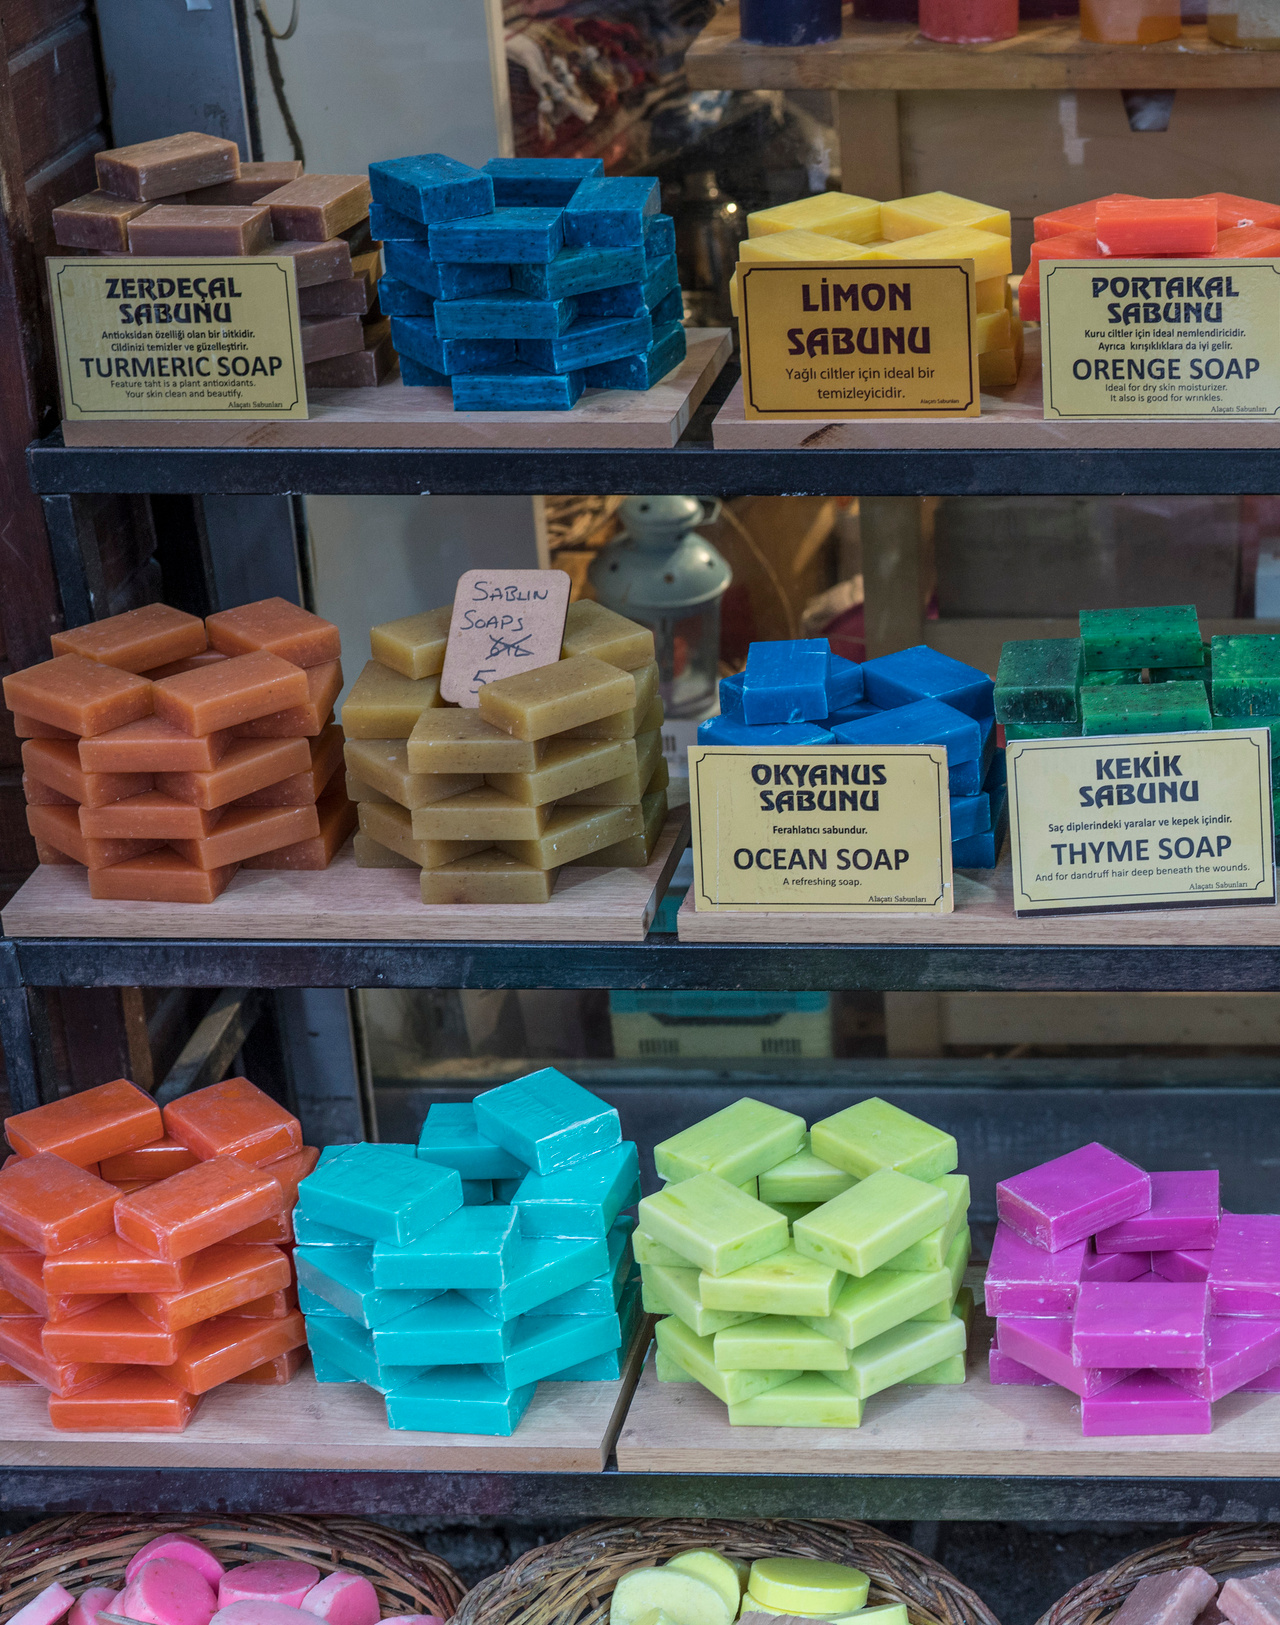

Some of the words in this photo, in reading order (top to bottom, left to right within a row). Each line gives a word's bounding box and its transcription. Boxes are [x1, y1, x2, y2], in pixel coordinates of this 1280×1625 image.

[106, 278, 242, 304] ZERDEÇAL
[802, 278, 911, 311] LİMON
[1092, 277, 1239, 300] PORTAKAL
[119, 301, 231, 326] SABUNU
[1108, 302, 1222, 326] SABUNU
[101, 330, 154, 340] Antioksidan
[154, 329, 185, 341] özelliği
[186, 329, 207, 339] olan
[207, 329, 221, 339] bir
[222, 329, 256, 339] bitkidir.
[787, 327, 930, 358] SABUNU
[1084, 329, 1106, 338] Kuru
[1107, 328, 1133, 338] ciltler
[1135, 328, 1151, 340] için
[1152, 328, 1175, 338] ideal
[1176, 328, 1246, 338] nemlendiricidir.
[110, 342, 145, 352] Cildinizi
[146, 342, 183, 352] temizler
[184, 344, 195, 352] ve
[196, 341, 249, 353] güzelleştirir.
[80, 357, 210, 377] TURMERIC
[218, 357, 282, 376] SOAP
[785, 367, 817, 383] Yağlı
[819, 367, 856, 380] ciltler
[858, 367, 881, 382] için
[883, 366, 915, 379] ideal
[917, 366, 935, 379] bir
[1073, 359, 1180, 380] ORENGE
[1190, 358, 1259, 379] SOAP
[817, 386, 906, 402] temizleyicidir.
[752, 764, 886, 788] OKYANUS
[1096, 751, 1182, 780] KEKİK
[760, 790, 879, 813] SABUNU
[1079, 779, 1198, 808] SABUNU
[772, 825, 820, 835] Ferahlatıcı
[822, 825, 868, 835] sabundur.
[1048, 823, 1064, 834] Saç
[1066, 819, 1122, 833] diplerindeki
[1123, 818, 1157, 831] yaralar
[1158, 819, 1170, 827] ve
[1171, 815, 1200, 828] kepek
[1201, 814, 1233, 827] içindir.
[734, 848, 826, 870] OCEAN
[837, 849, 909, 870] SOAP
[1051, 839, 1149, 865] THYME
[1159, 836, 1231, 859] SOAP
[782, 877, 790, 886] A
[791, 877, 837, 888] refreshing
[838, 879, 862, 888] soap.
